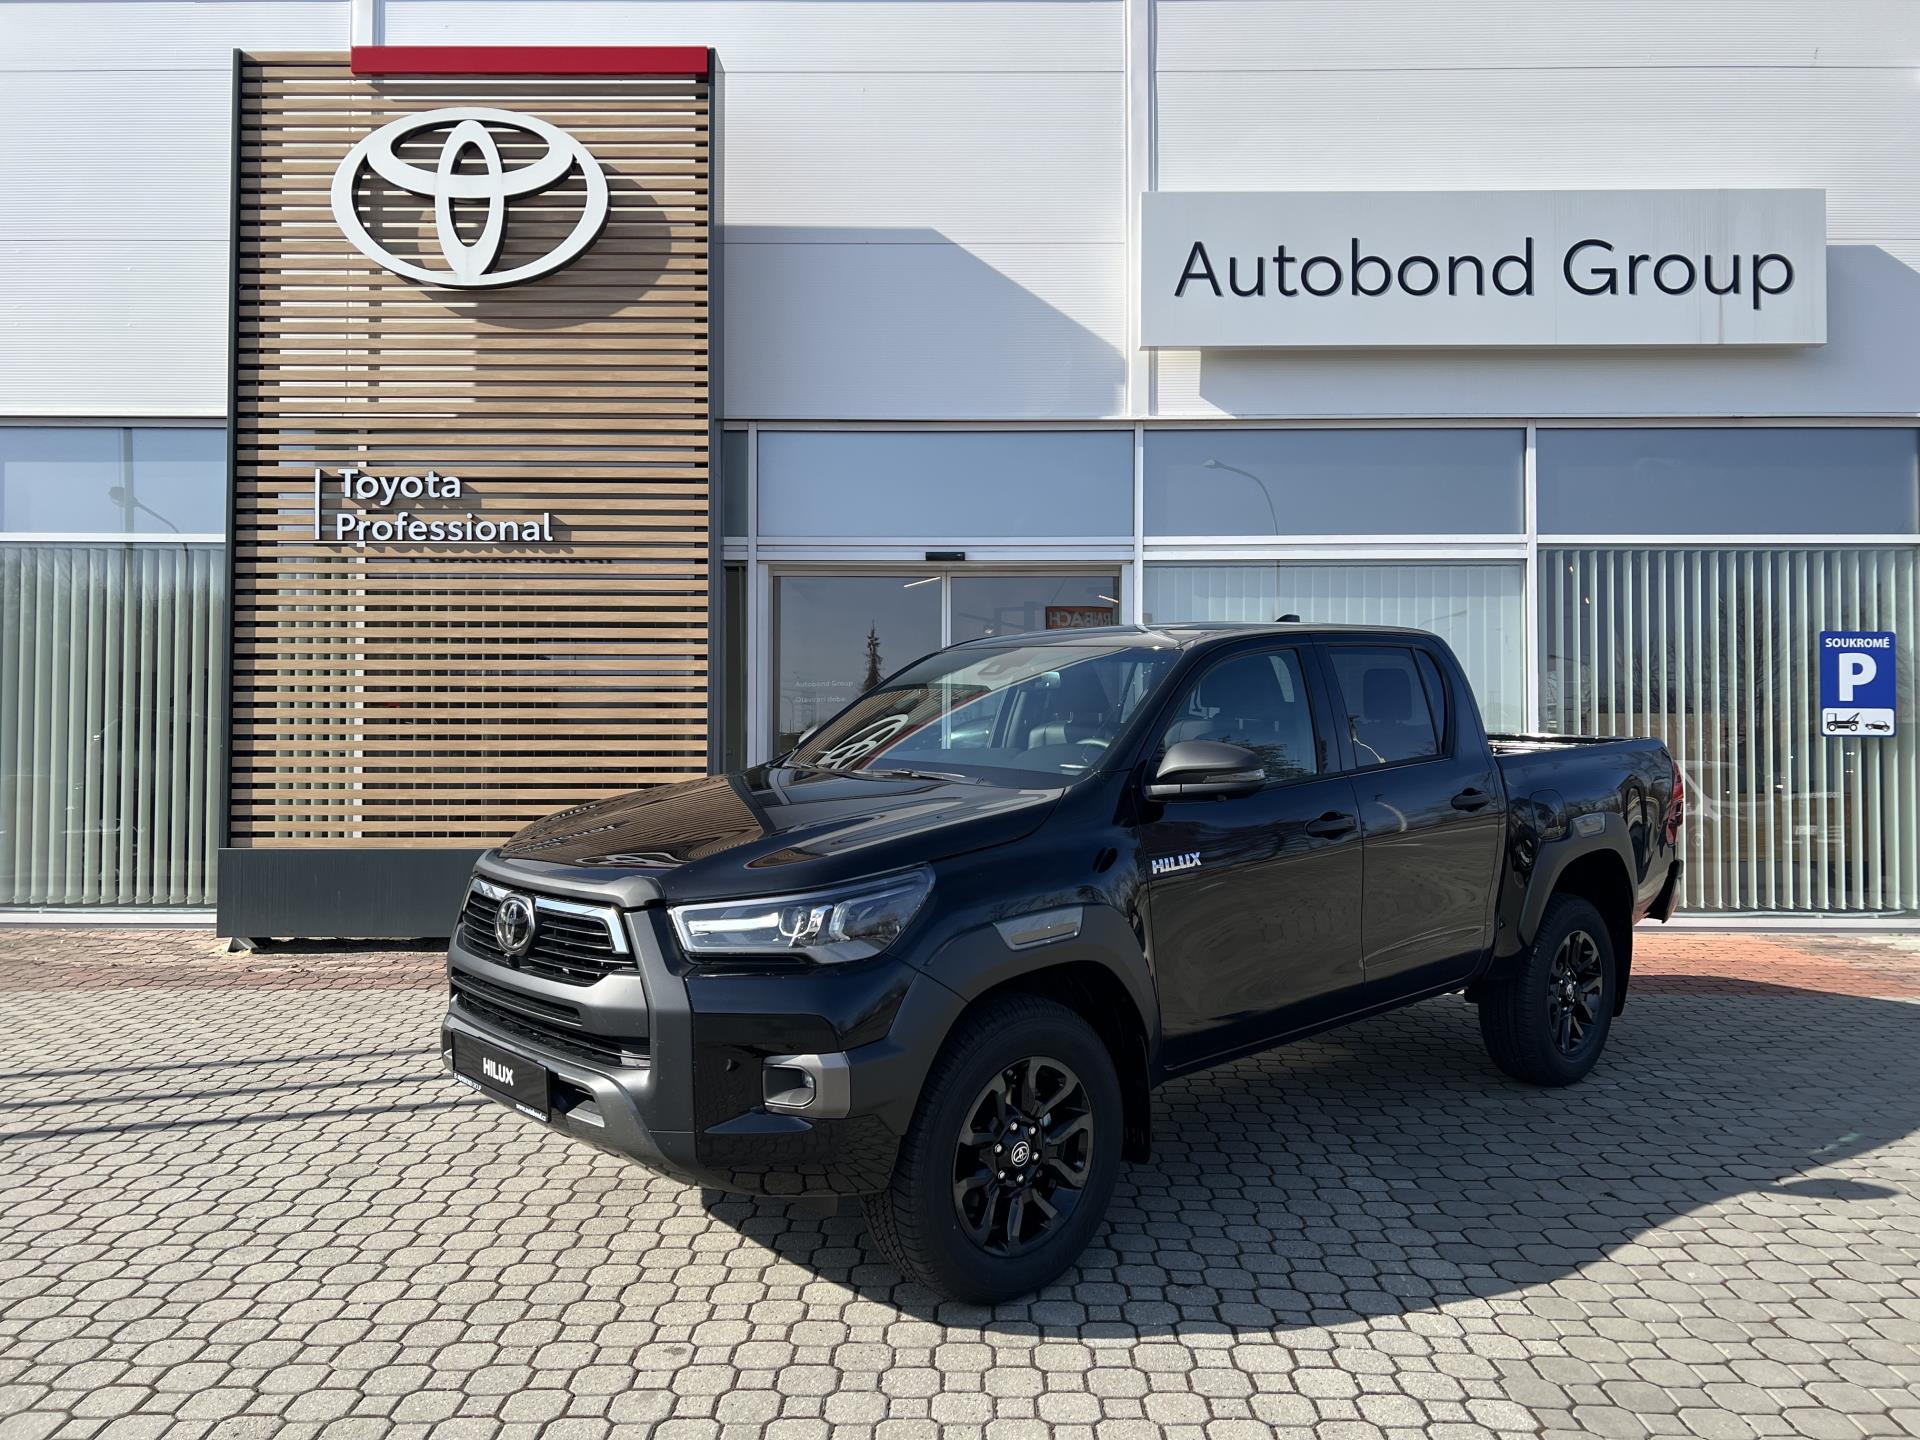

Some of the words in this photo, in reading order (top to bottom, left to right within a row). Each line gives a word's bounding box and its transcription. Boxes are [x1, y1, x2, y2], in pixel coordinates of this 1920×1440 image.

[1174, 236, 1534, 298] Autobond
[1563, 238, 1795, 311] Group
[337, 468, 462, 506] Toyota
[336, 511, 554, 542] Professional
[1825, 637, 1890, 648] SOUKROMÉ
[1838, 652, 1877, 702] P
[1151, 851, 1202, 875] HILUX
[482, 1057, 514, 1087] HILUX
